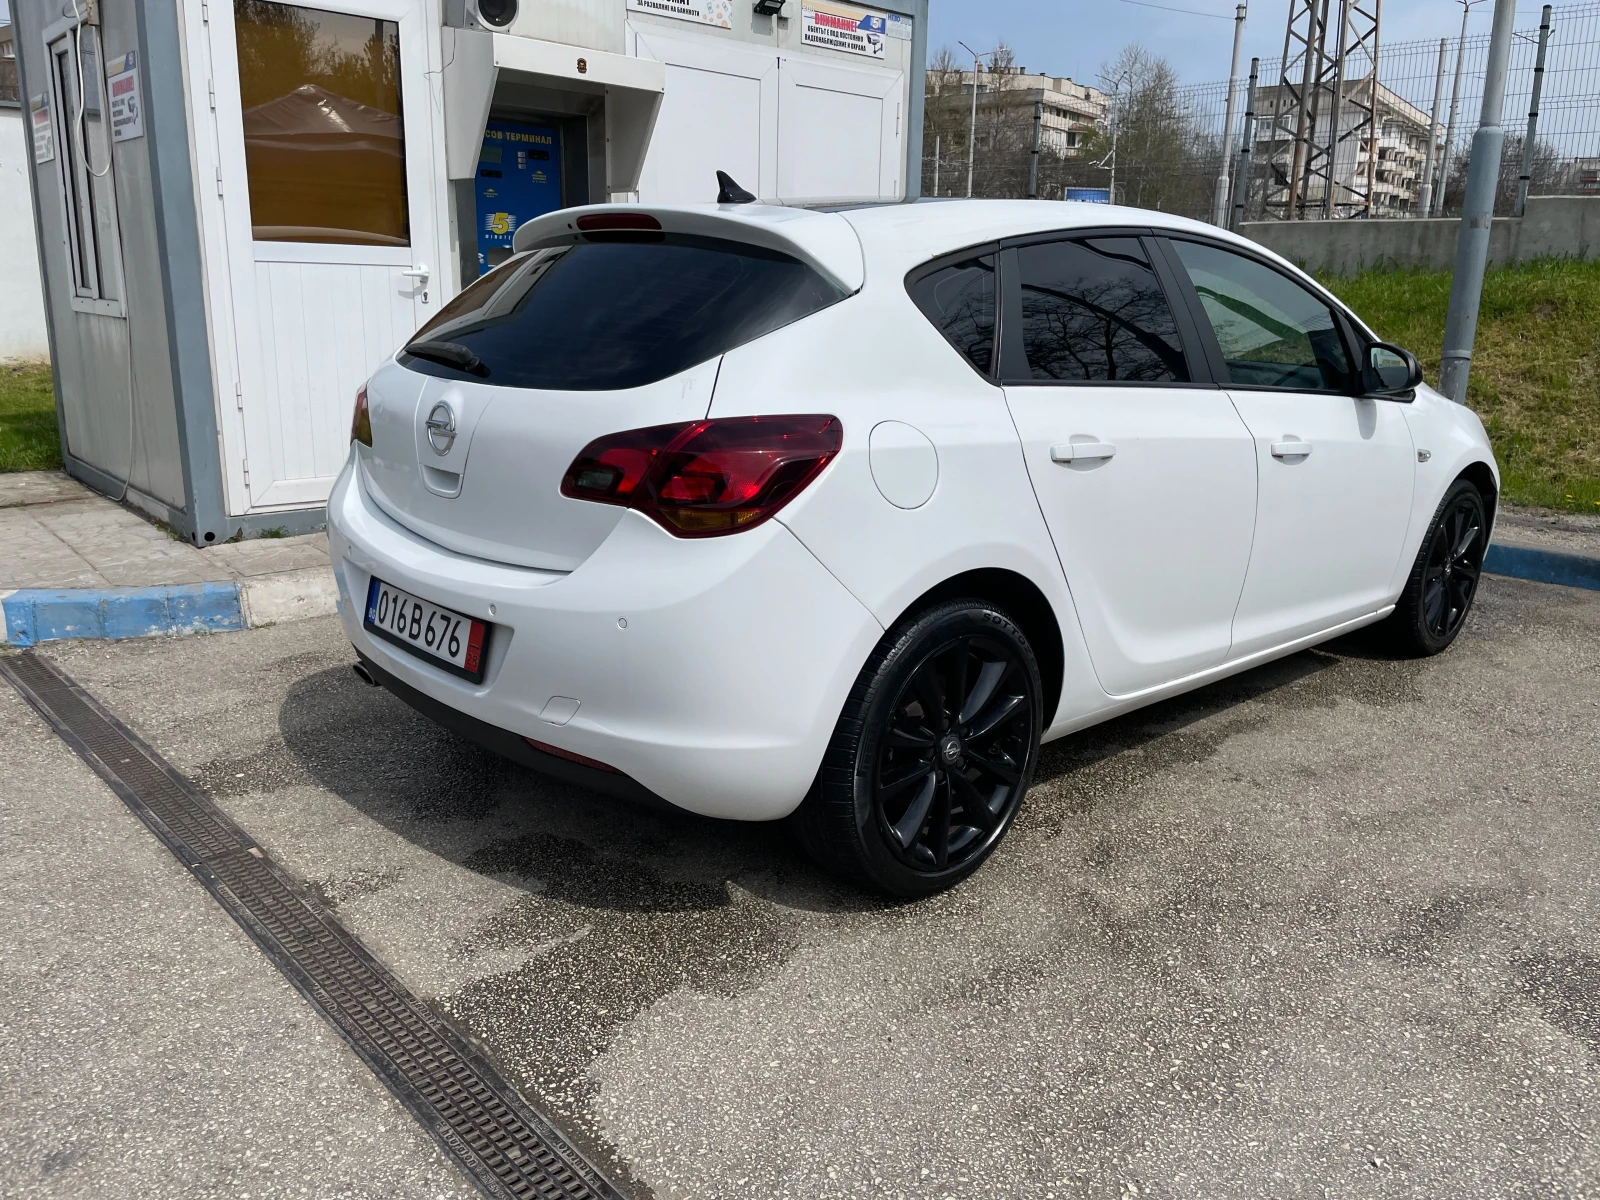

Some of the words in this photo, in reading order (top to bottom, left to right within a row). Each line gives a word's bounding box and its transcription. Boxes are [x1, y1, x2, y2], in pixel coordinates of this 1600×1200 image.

[485, 129, 503, 140] СОВ
[505, 131, 552, 145] ТЕРМИНАЛ
[491, 212, 509, 235] 5
[378, 590, 461, 658] 016B676
